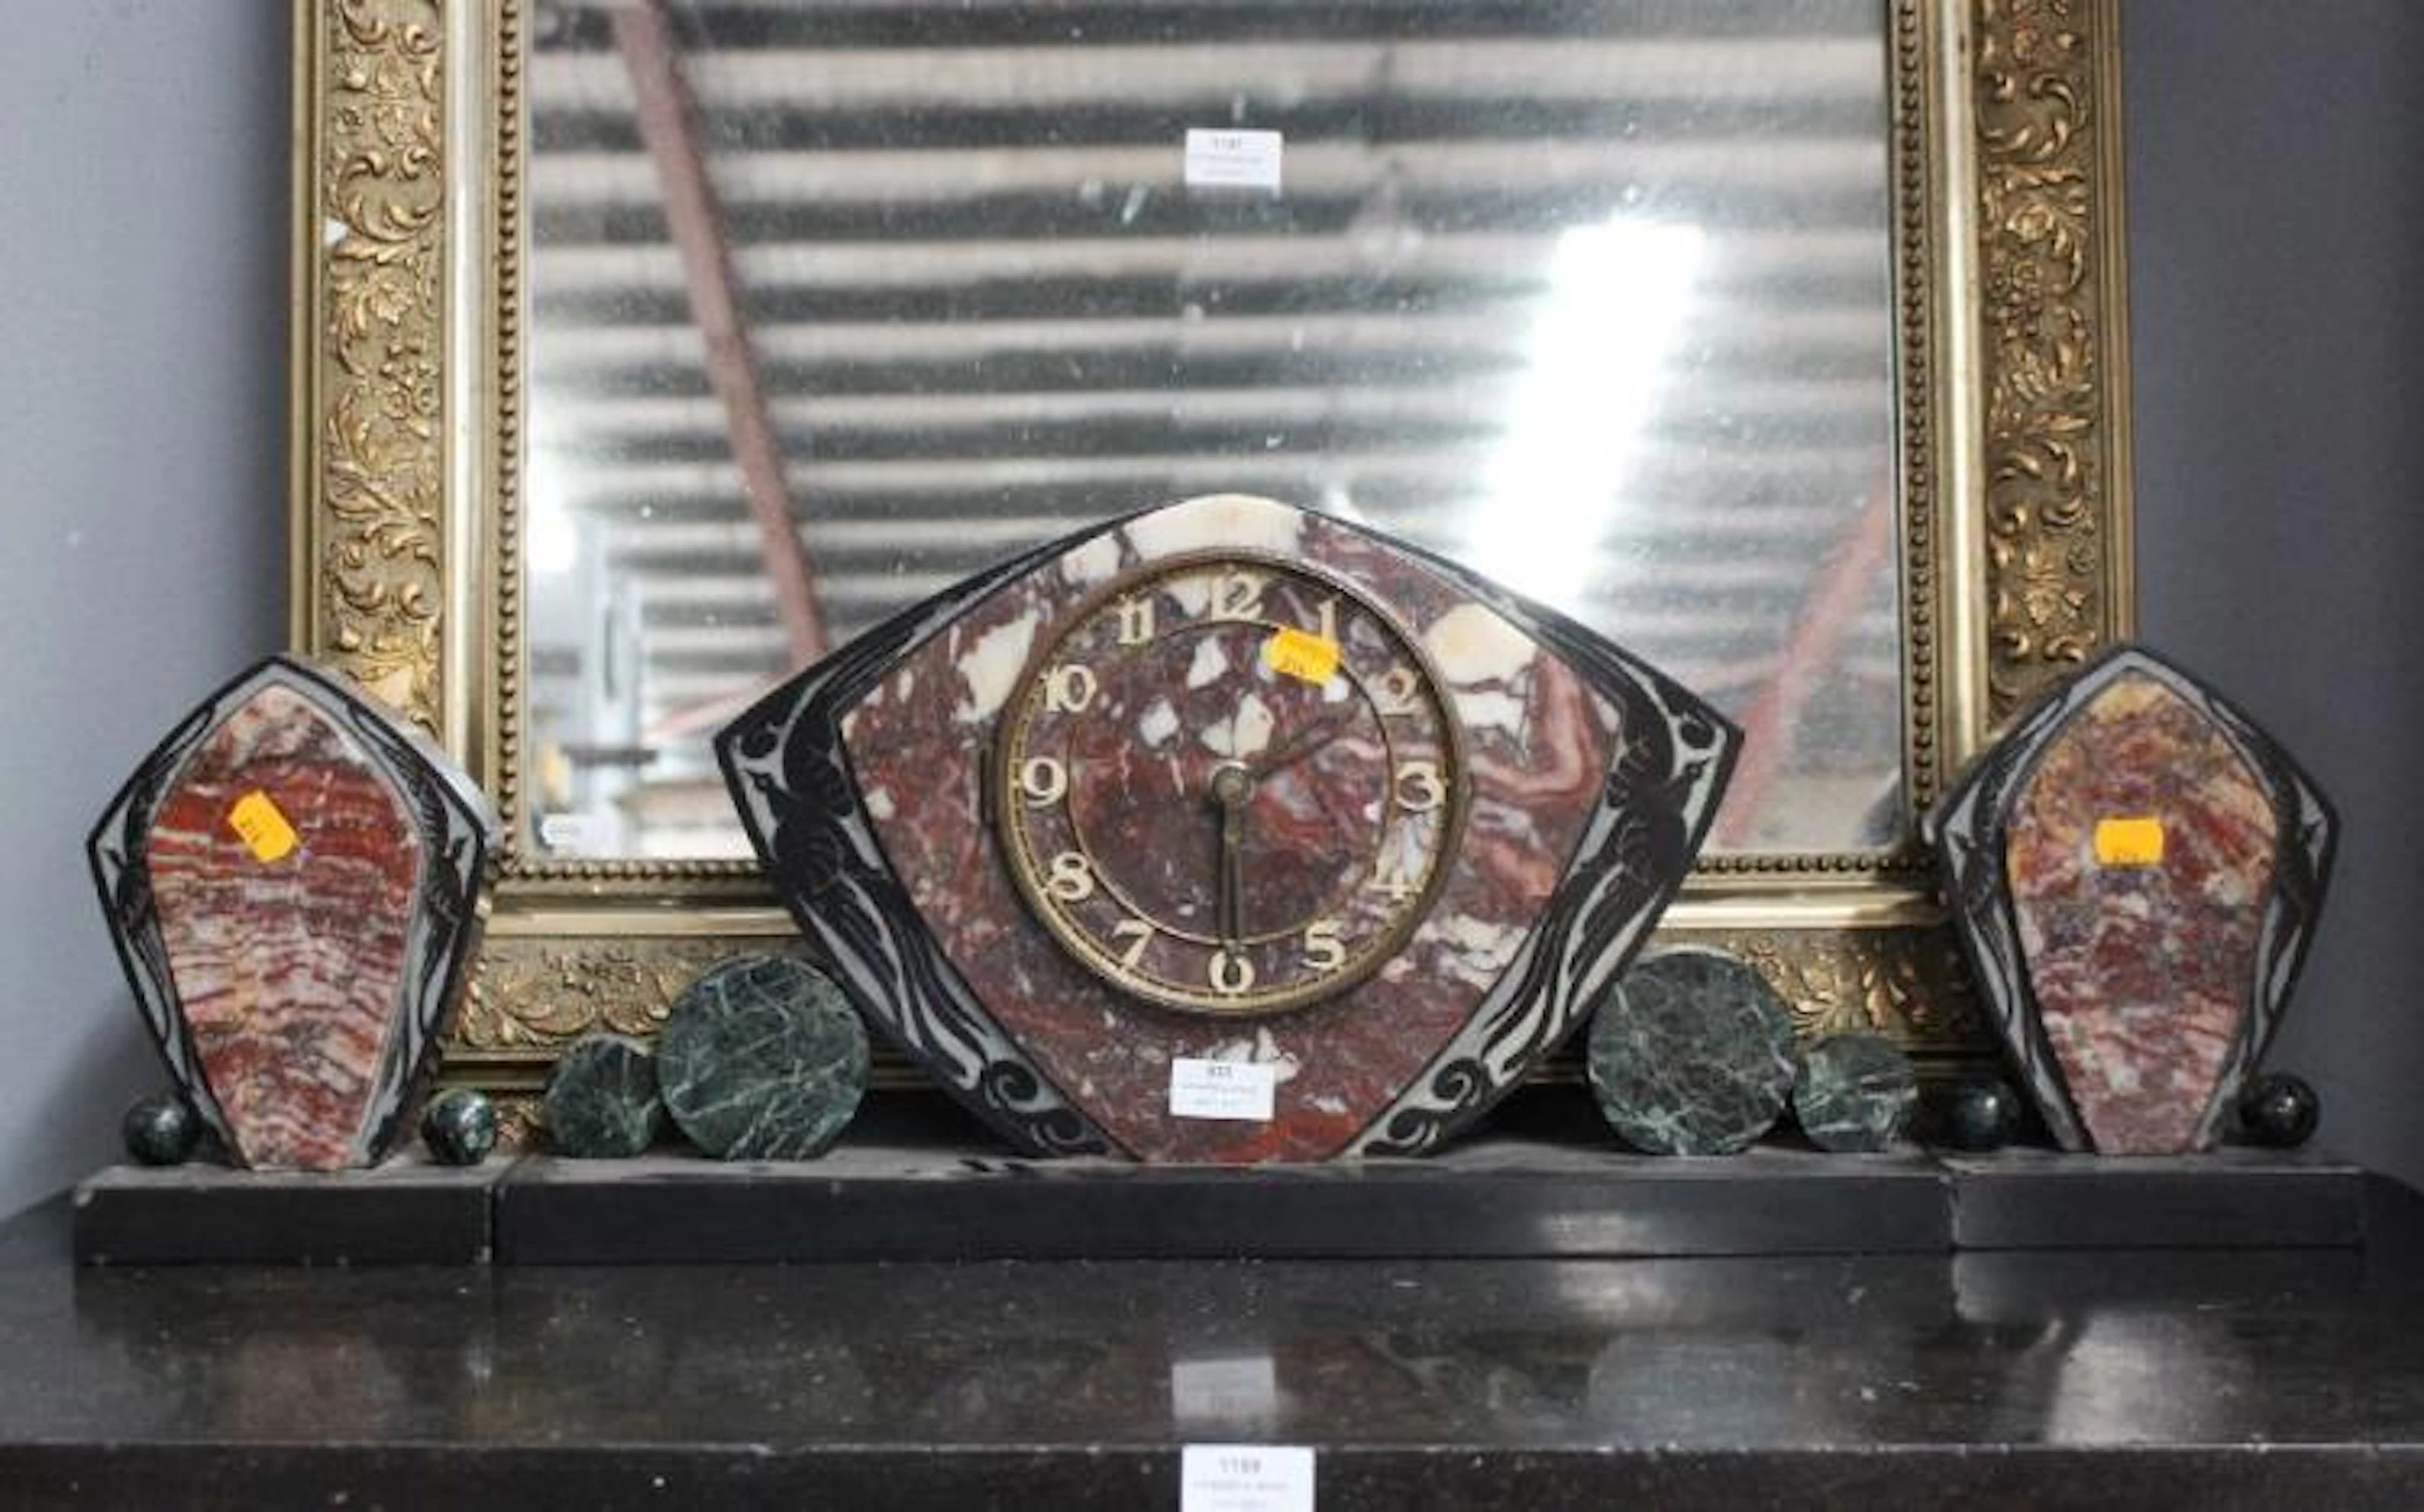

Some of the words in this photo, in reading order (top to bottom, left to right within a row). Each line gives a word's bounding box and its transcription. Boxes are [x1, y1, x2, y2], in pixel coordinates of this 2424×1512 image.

[1118, 595, 1155, 644] 11
[1209, 573, 1263, 621] 12
[1317, 598, 1336, 641] 1
[1041, 664, 1097, 712] 10
[1380, 668, 1424, 716] 2
[1023, 759, 1067, 808] 9
[1394, 761, 1446, 811] 3
[1048, 851, 1094, 901] 8
[1365, 849, 1424, 901] 4
[1112, 921, 1154, 969] 7
[1302, 921, 1345, 970] 5
